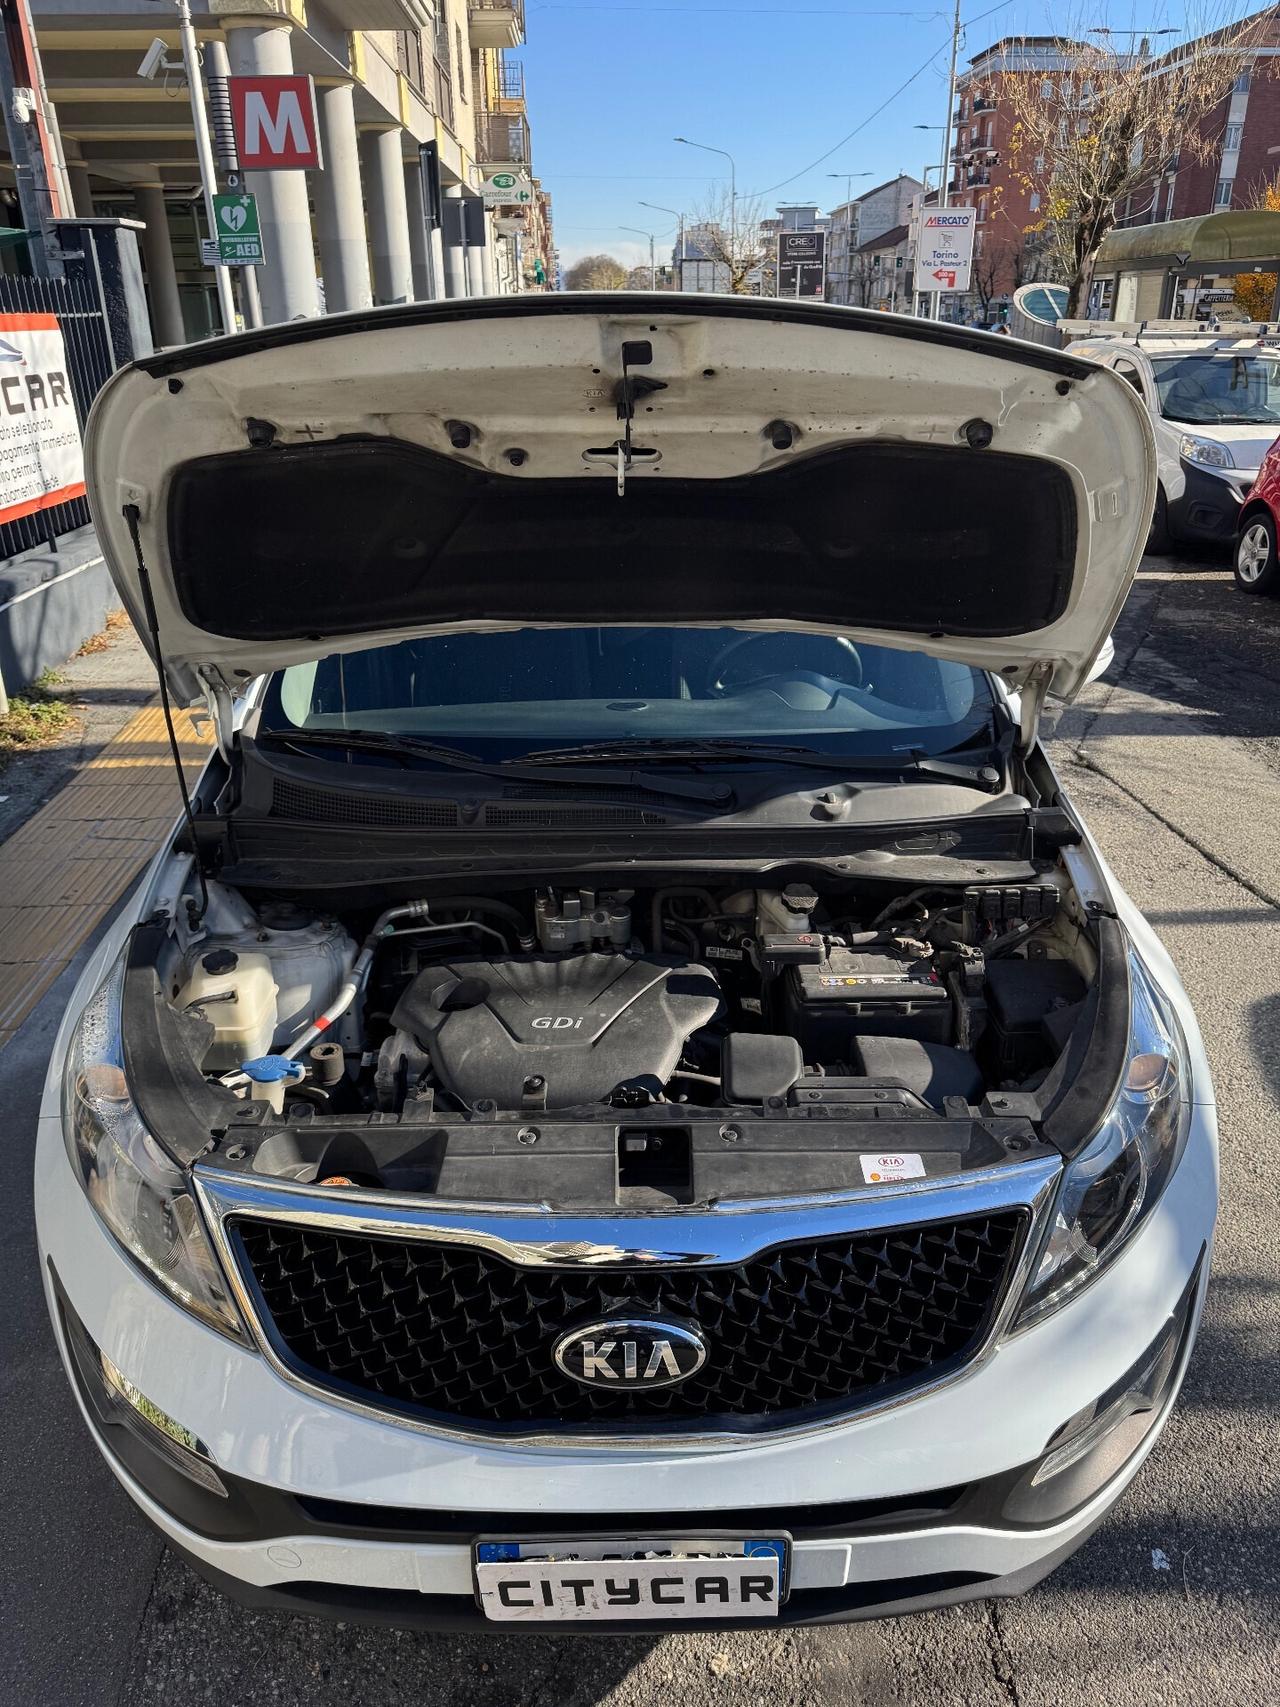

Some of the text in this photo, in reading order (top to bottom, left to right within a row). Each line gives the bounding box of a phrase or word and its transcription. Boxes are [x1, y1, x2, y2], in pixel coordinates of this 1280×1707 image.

[245, 90, 312, 154] M
[925, 215, 970, 228] MERCATO
[236, 243, 260, 256] AED
[932, 249, 959, 259] Torino
[0, 371, 69, 416] CAR
[531, 1016, 584, 1029] GDi
[882, 1158, 901, 1166] KIA
[581, 1340, 682, 1379] KIA
[497, 1574, 775, 1608] CITYCAR
